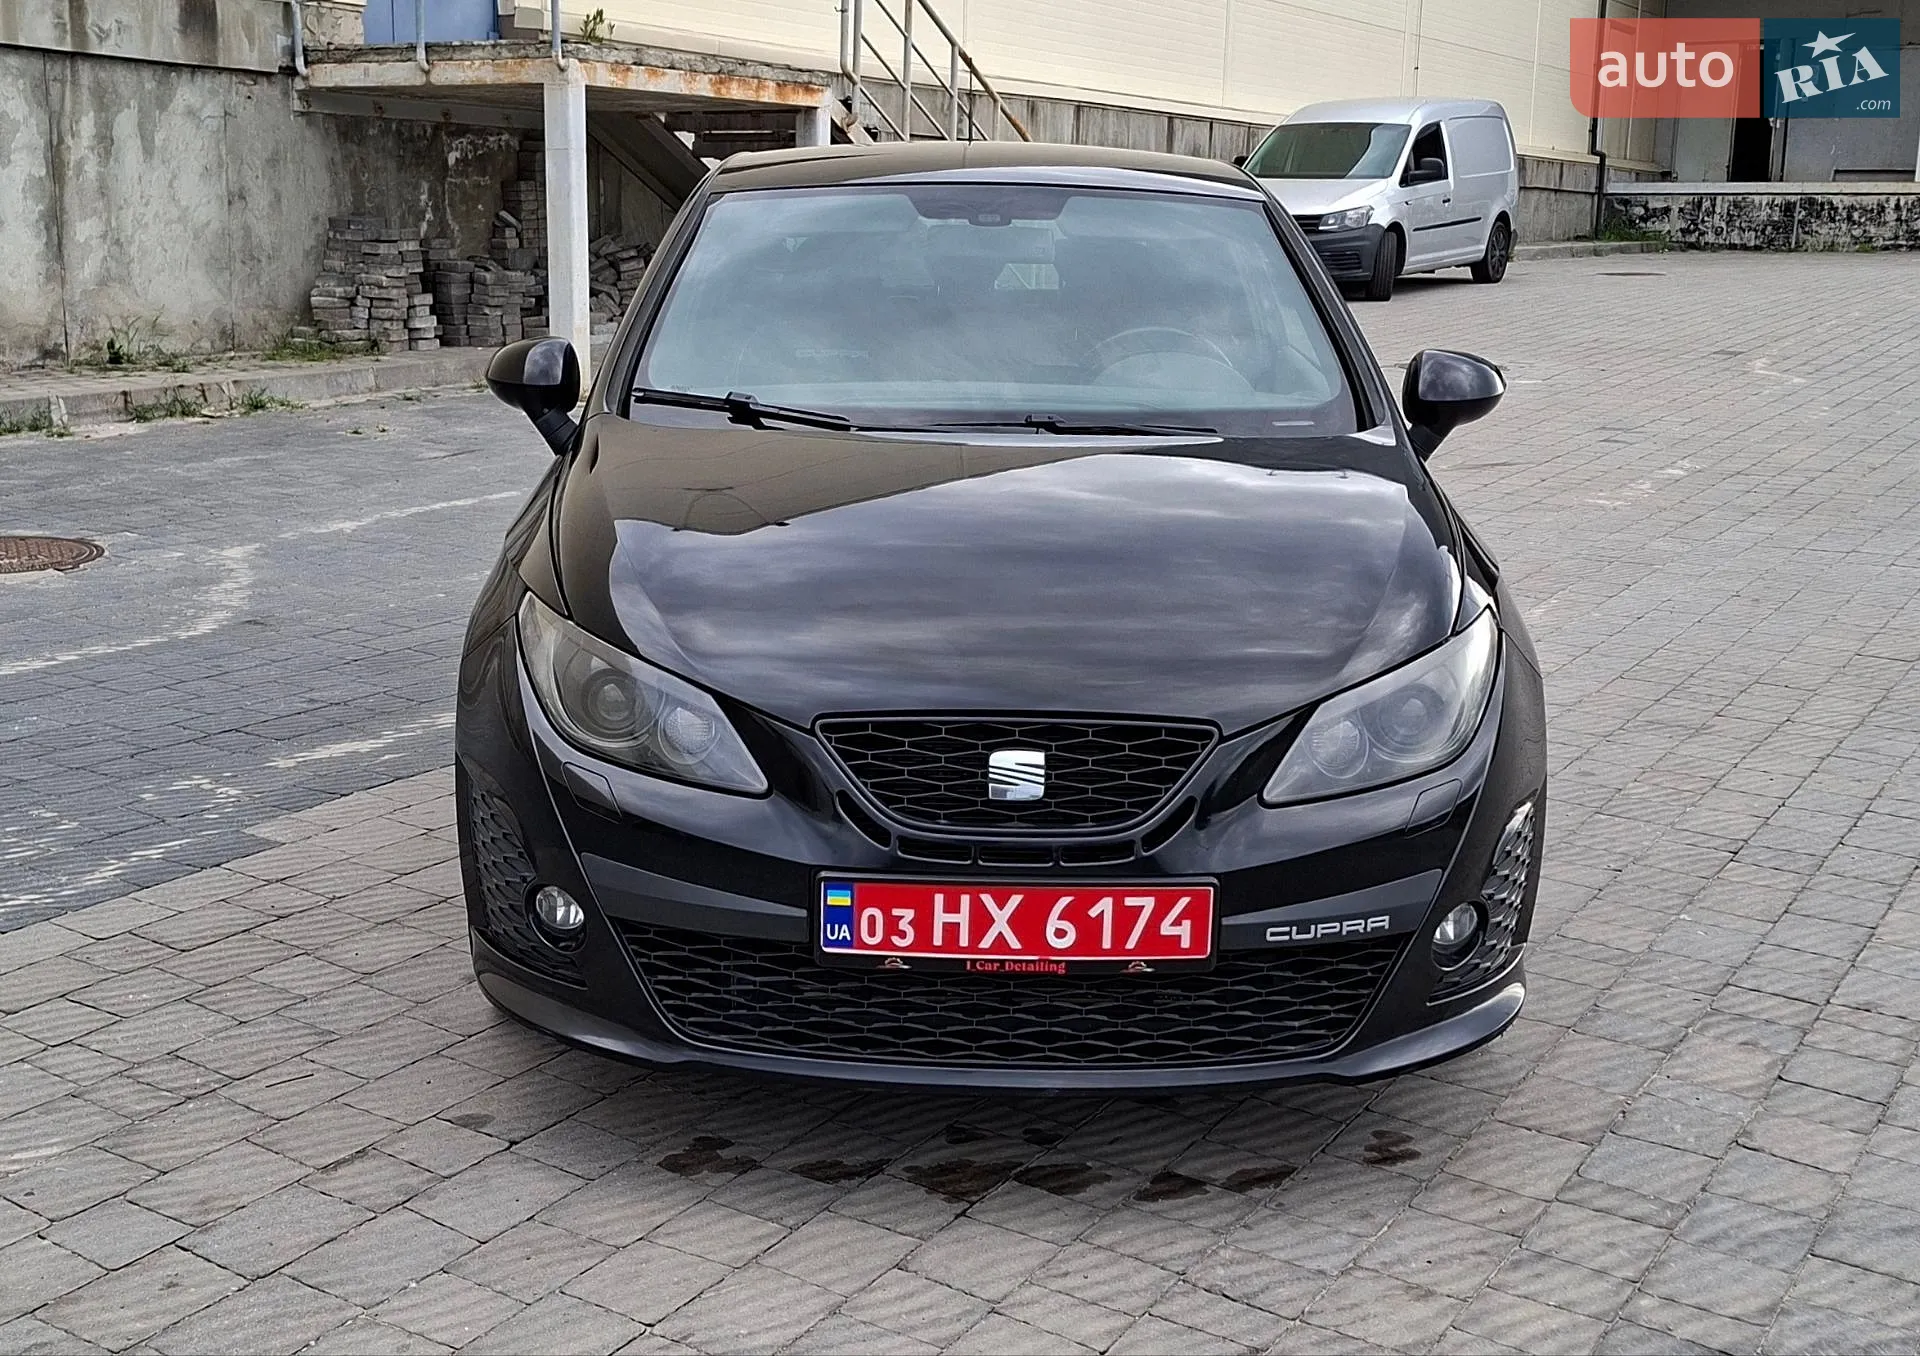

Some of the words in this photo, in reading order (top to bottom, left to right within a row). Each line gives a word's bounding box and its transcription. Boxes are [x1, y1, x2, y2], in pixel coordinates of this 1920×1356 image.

[826, 923, 851, 941] UA
[860, 907, 915, 948] 03
[932, 893, 1025, 950] HX
[1045, 896, 1192, 950] 6174
[1266, 915, 1390, 942] CUPRA
